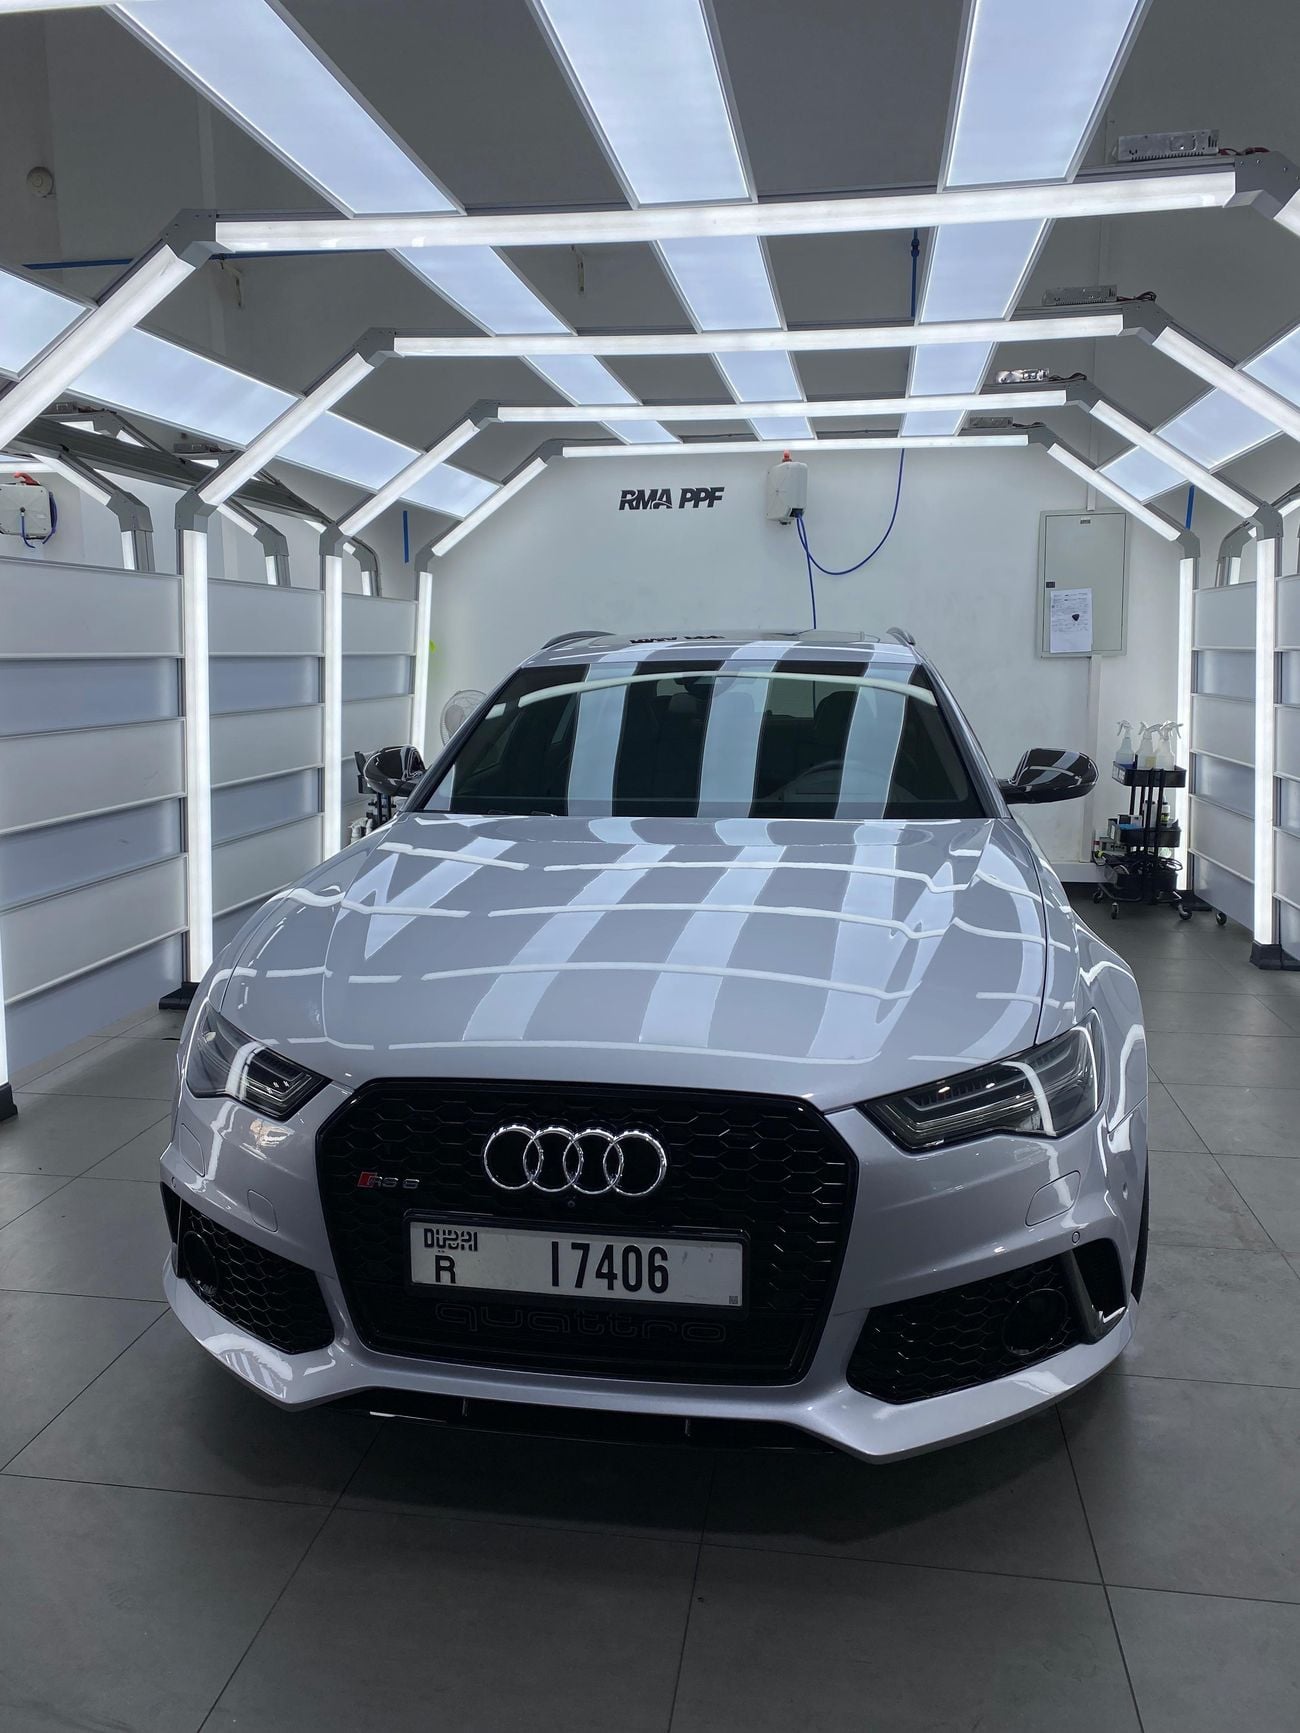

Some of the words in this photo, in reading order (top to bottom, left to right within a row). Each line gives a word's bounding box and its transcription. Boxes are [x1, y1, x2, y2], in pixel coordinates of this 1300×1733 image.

[619, 488, 673, 510] RMA
[678, 487, 725, 508] PPF
[435, 1254, 457, 1284] R
[551, 1241, 669, 1294] 17406
[434, 1301, 727, 1343] quattro
